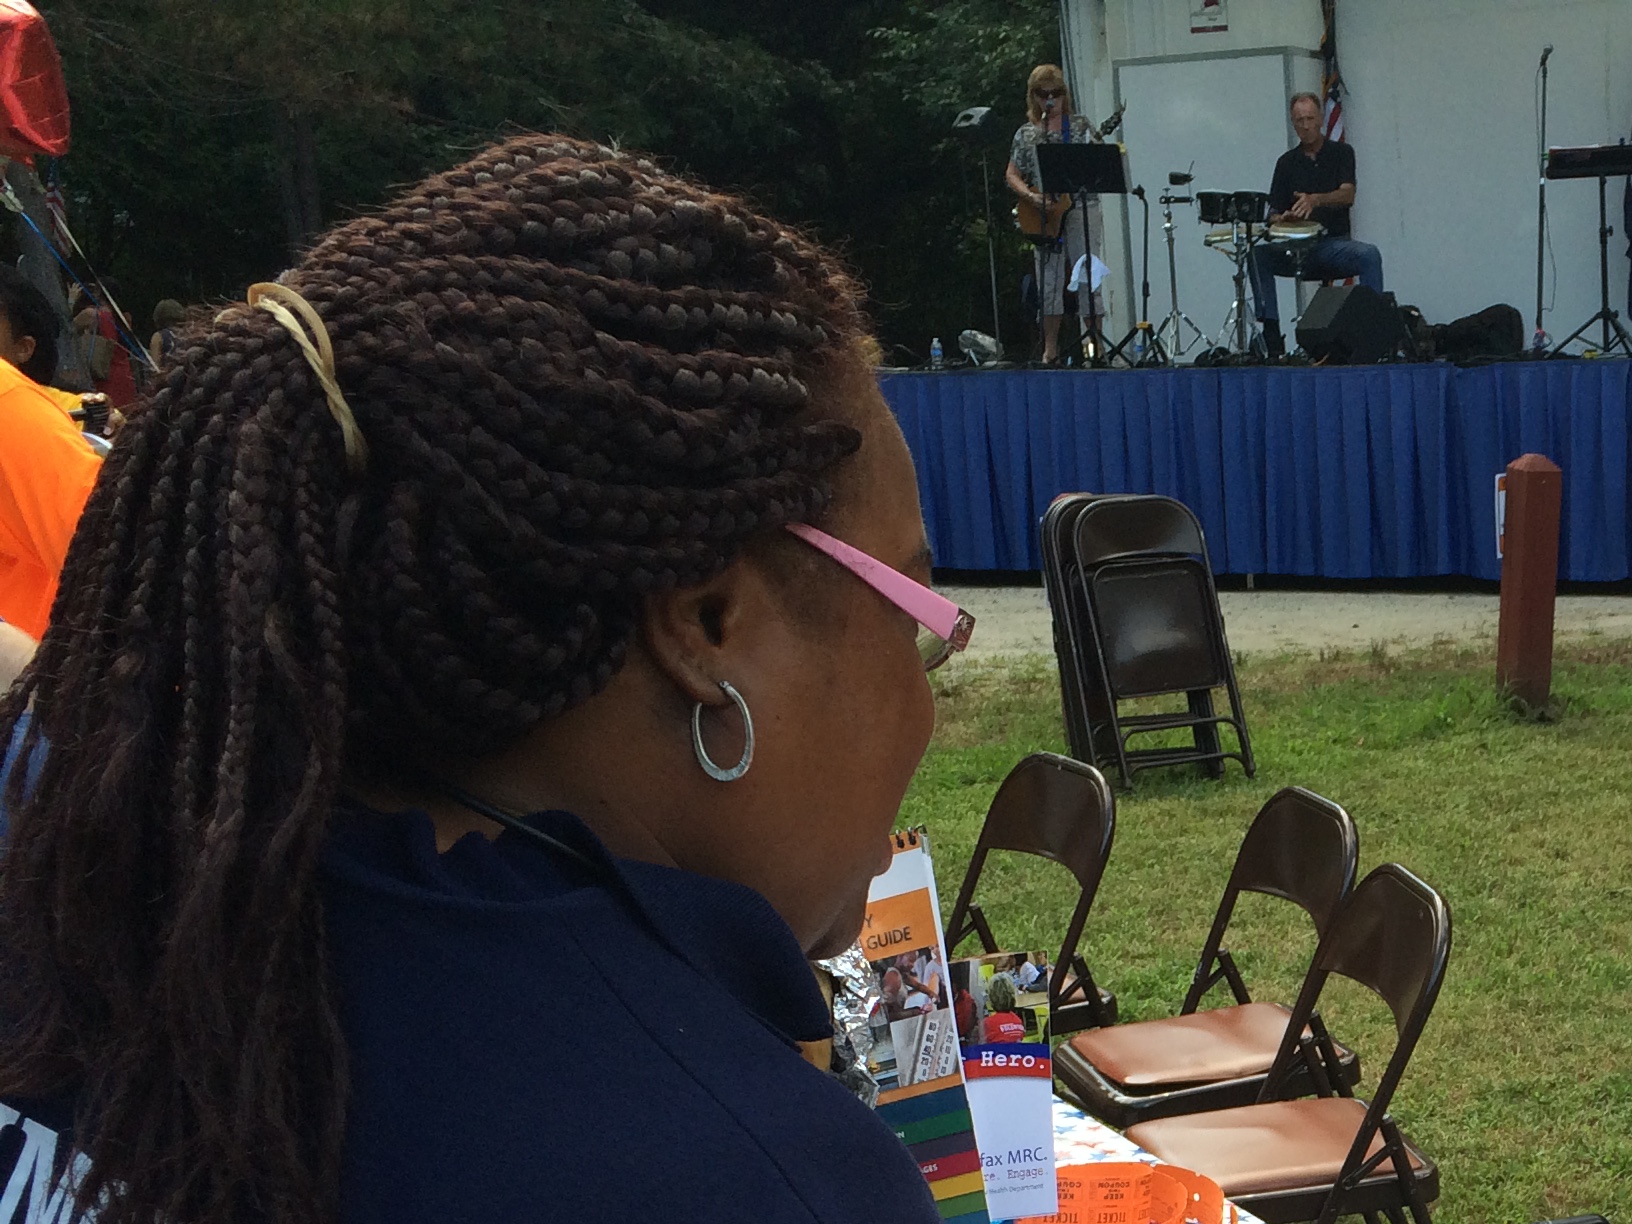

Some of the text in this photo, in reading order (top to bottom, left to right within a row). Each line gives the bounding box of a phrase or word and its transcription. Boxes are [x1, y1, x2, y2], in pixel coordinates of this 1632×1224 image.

[866, 926, 913, 950] GUIDE
[980, 1050, 1047, 1071] Hero.
[1007, 1146, 1048, 1164] MRC.
[1097, 1212, 1126, 1224] TICKET
